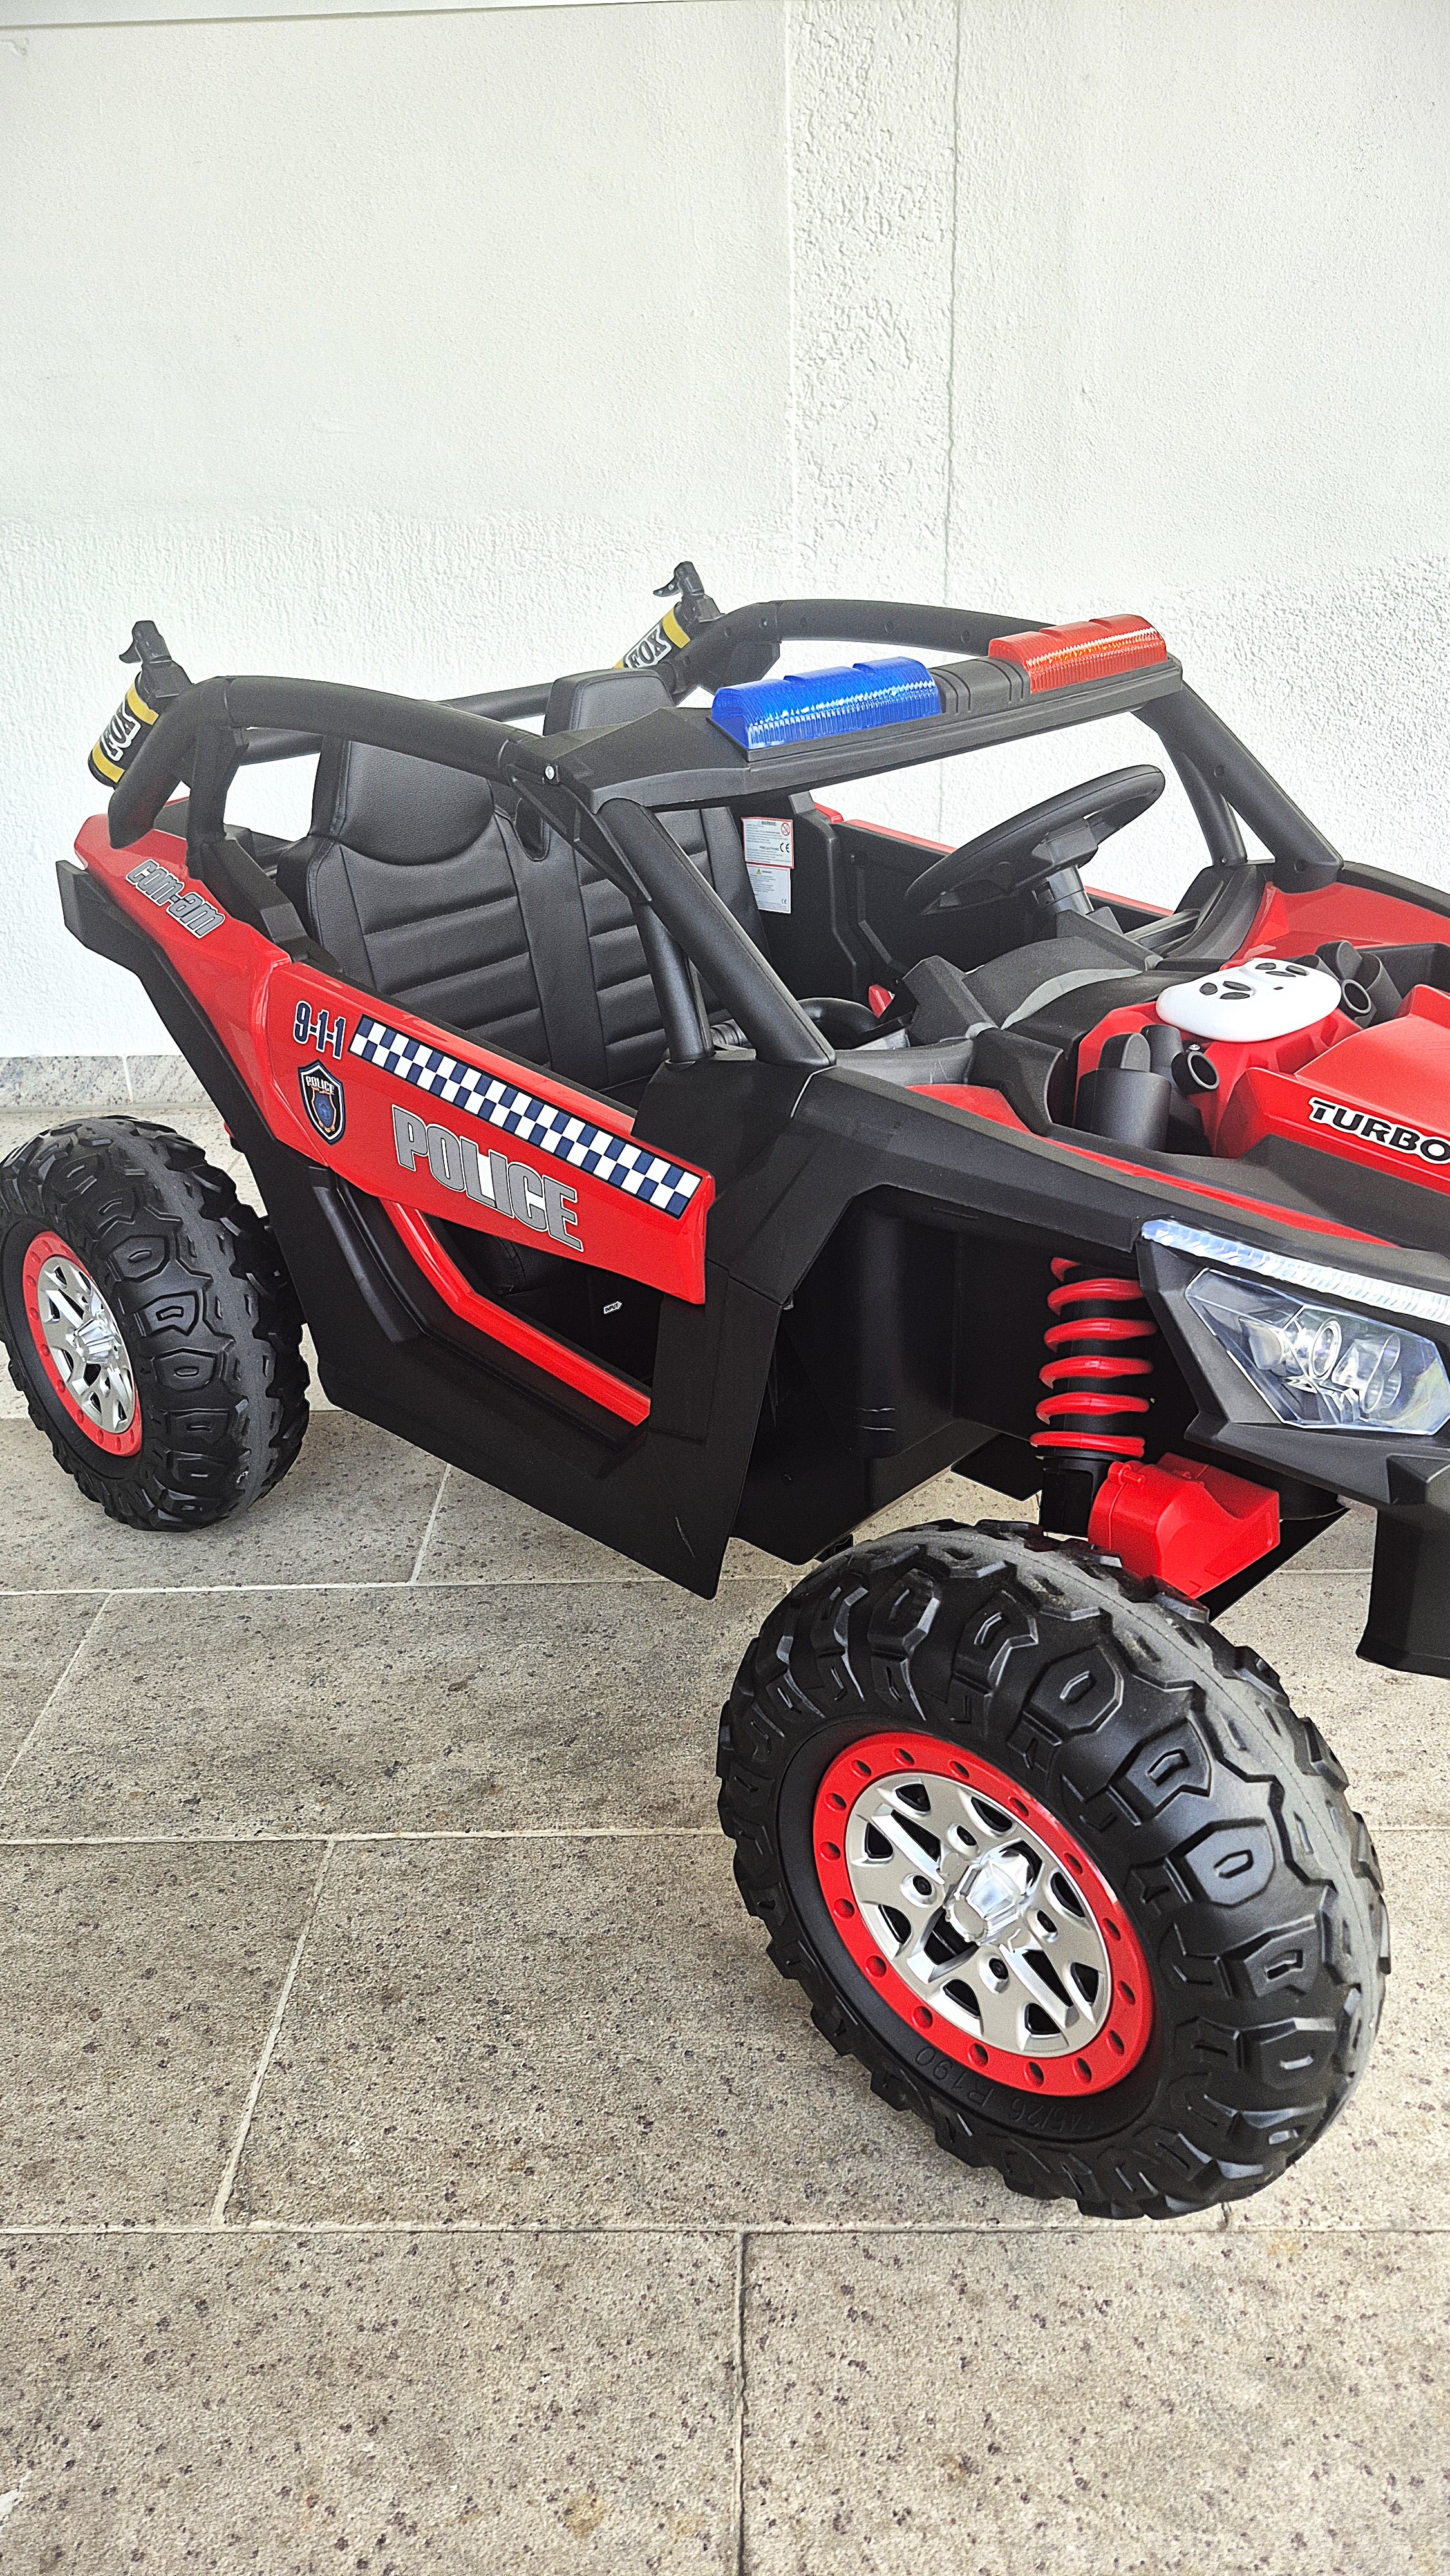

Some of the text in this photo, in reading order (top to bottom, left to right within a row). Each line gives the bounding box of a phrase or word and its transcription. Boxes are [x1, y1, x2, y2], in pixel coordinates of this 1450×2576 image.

[626, 625, 670, 668] FOX
[100, 699, 139, 759] FOX
[294, 1001, 346, 1059] 9-1-1
[305, 1075, 335, 1095] POLICE
[1311, 1099, 1450, 1162] TURBO
[392, 1104, 584, 1251] POLICE
